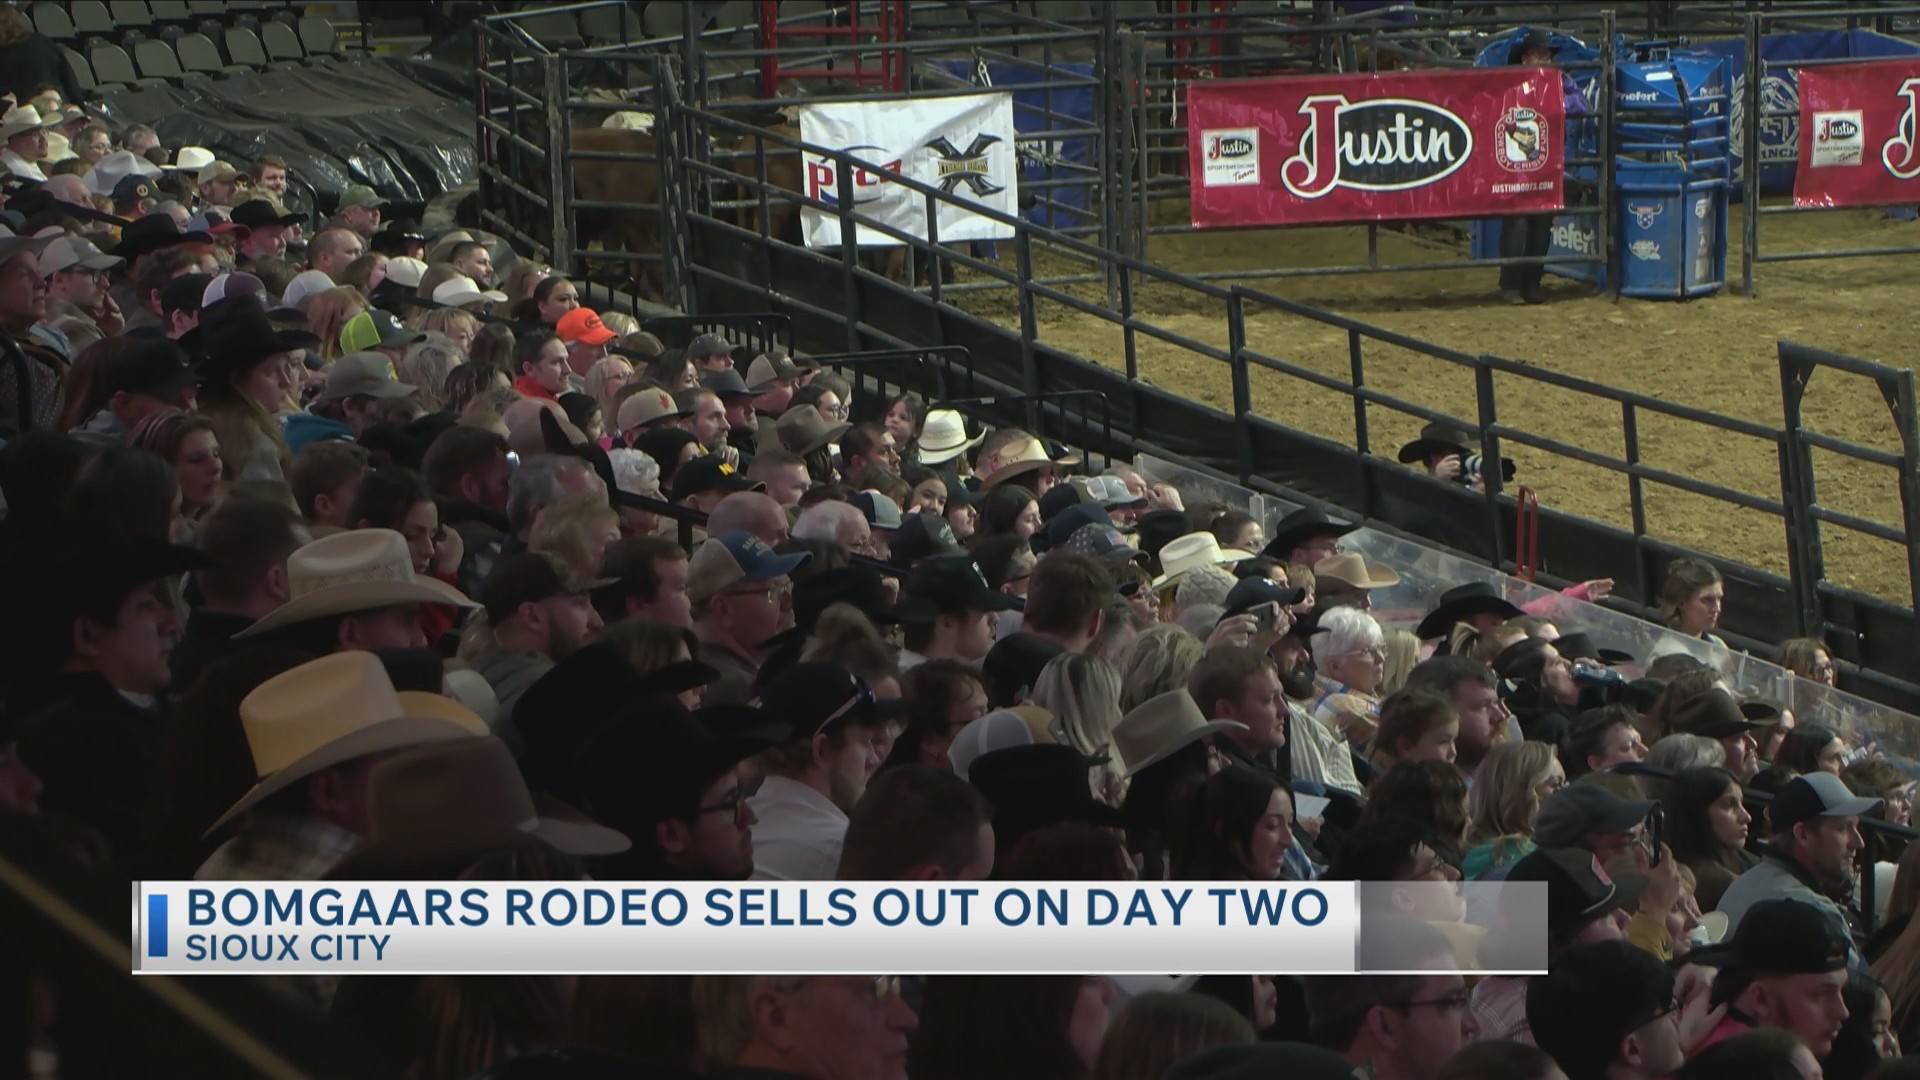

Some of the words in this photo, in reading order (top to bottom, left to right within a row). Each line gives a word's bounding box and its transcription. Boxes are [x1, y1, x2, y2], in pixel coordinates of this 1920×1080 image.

[1818, 117, 1856, 142] Justin
[1208, 135, 1251, 160] Justin
[1281, 94, 1455, 199] Justin
[1497, 123, 1512, 167] COWBOY
[1513, 153, 1546, 170] CRISIS
[1539, 121, 1547, 153] FUND
[1492, 181, 1554, 194] JUSTINBOOTS.COM
